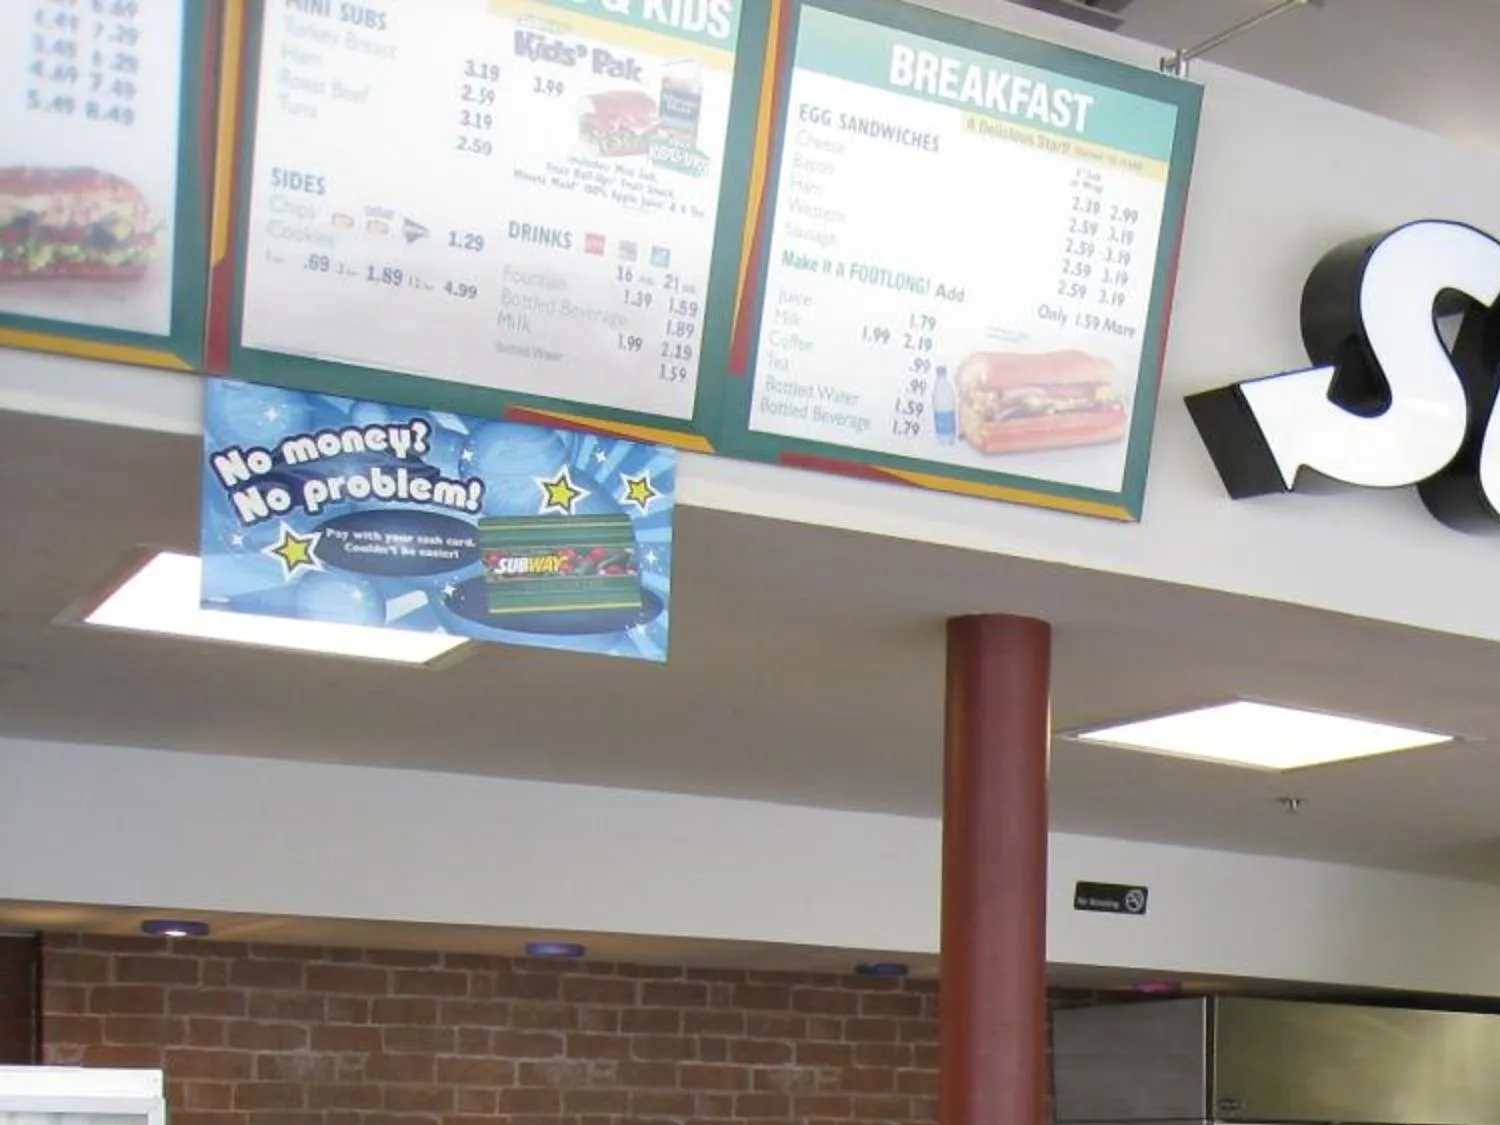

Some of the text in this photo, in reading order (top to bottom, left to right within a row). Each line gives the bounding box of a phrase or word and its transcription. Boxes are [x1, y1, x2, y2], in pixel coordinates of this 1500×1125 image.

[339, 3, 388, 31] SUBS
[592, 48, 643, 83] Pak
[460, 84, 496, 107] 2.59
[889, 42, 1094, 134] BREAKFAST
[458, 109, 493, 131] 3.19
[799, 103, 941, 154] EGG SANDWICHES
[456, 134, 494, 157] 2.59
[270, 167, 328, 196] SIDES
[448, 230, 485, 253] 1.29
[508, 220, 574, 251] DRINKS
[935, 282, 966, 303] Add
[616, 332, 644, 353] 1.99
[212, 418, 433, 488] No money?
[231, 468, 485, 525] No problem!
[326, 527, 348, 542] Pay
[354, 529, 382, 543] with
[384, 533, 414, 548] your
[494, 554, 569, 575] SUBWAY
